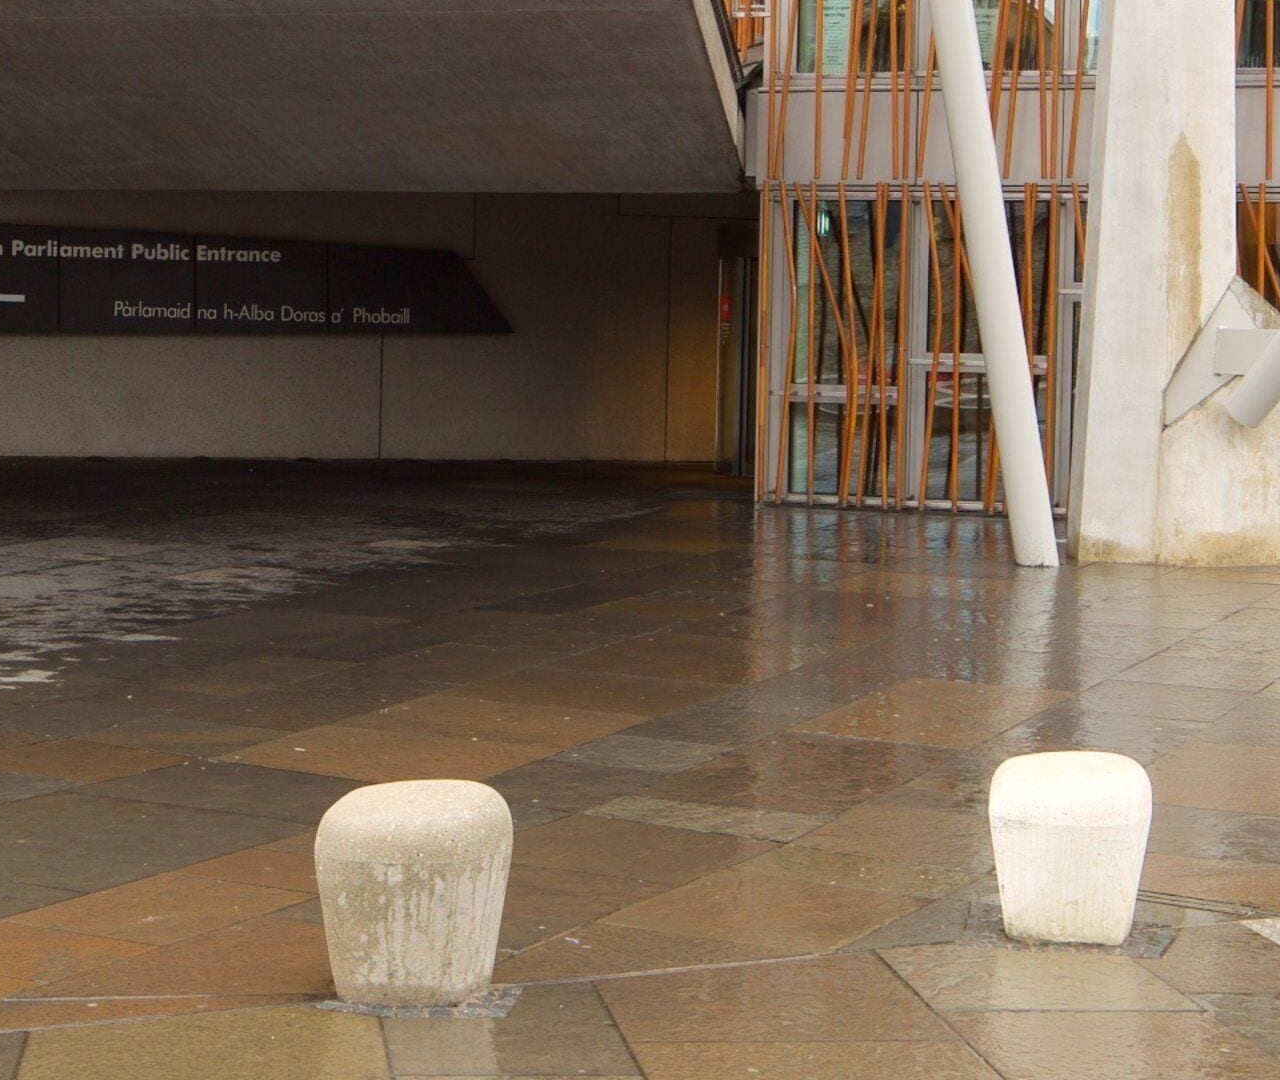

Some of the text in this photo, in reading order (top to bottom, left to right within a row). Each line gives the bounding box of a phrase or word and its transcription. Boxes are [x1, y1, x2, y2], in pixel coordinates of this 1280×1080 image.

[11, 239, 124, 259] Parliament
[131, 243, 190, 261] Public
[197, 245, 282, 262] Entrance
[114, 300, 191, 319] Pàrlamaid
[198, 308, 217, 320] na
[224, 303, 274, 321] h-Alba
[281, 305, 326, 322] Doras
[353, 307, 410, 324] Phobaill
